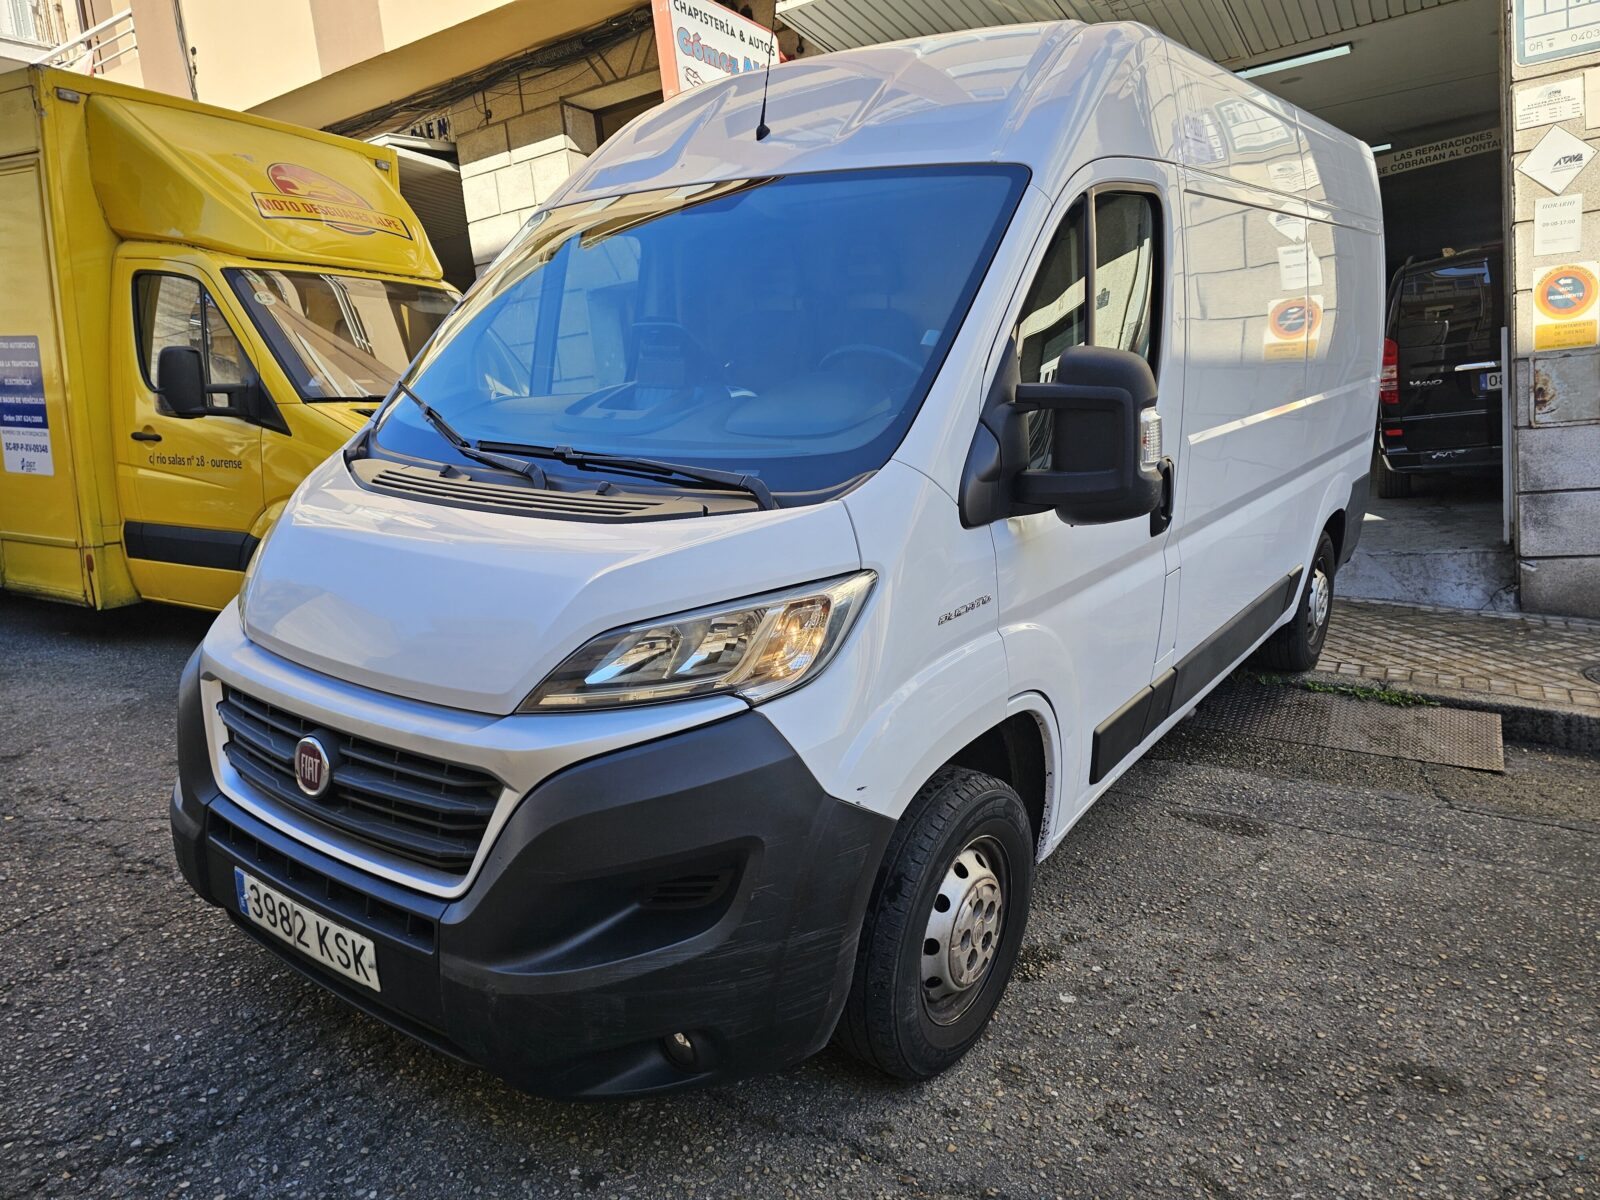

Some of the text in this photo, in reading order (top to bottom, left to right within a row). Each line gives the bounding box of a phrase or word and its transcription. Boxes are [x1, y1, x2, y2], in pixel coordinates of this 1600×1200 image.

[673, 0, 776, 56] CHAPISTERÍA & AUTOS
[677, 27, 740, 76] Gómez
[1390, 153, 1446, 173] COBRARAN
[1448, 149, 1462, 159] AL
[1393, 131, 1493, 162] LAS REPARACIONES
[257, 199, 402, 231] MOTO DESGUACES ALPE
[1542, 200, 1576, 209] HORARIO
[168, 453, 186, 466] salas
[196, 455, 205, 467] 28
[210, 457, 243, 469] ourense
[301, 754, 320, 784] FIAT
[249, 884, 371, 982] 3982 KSK
